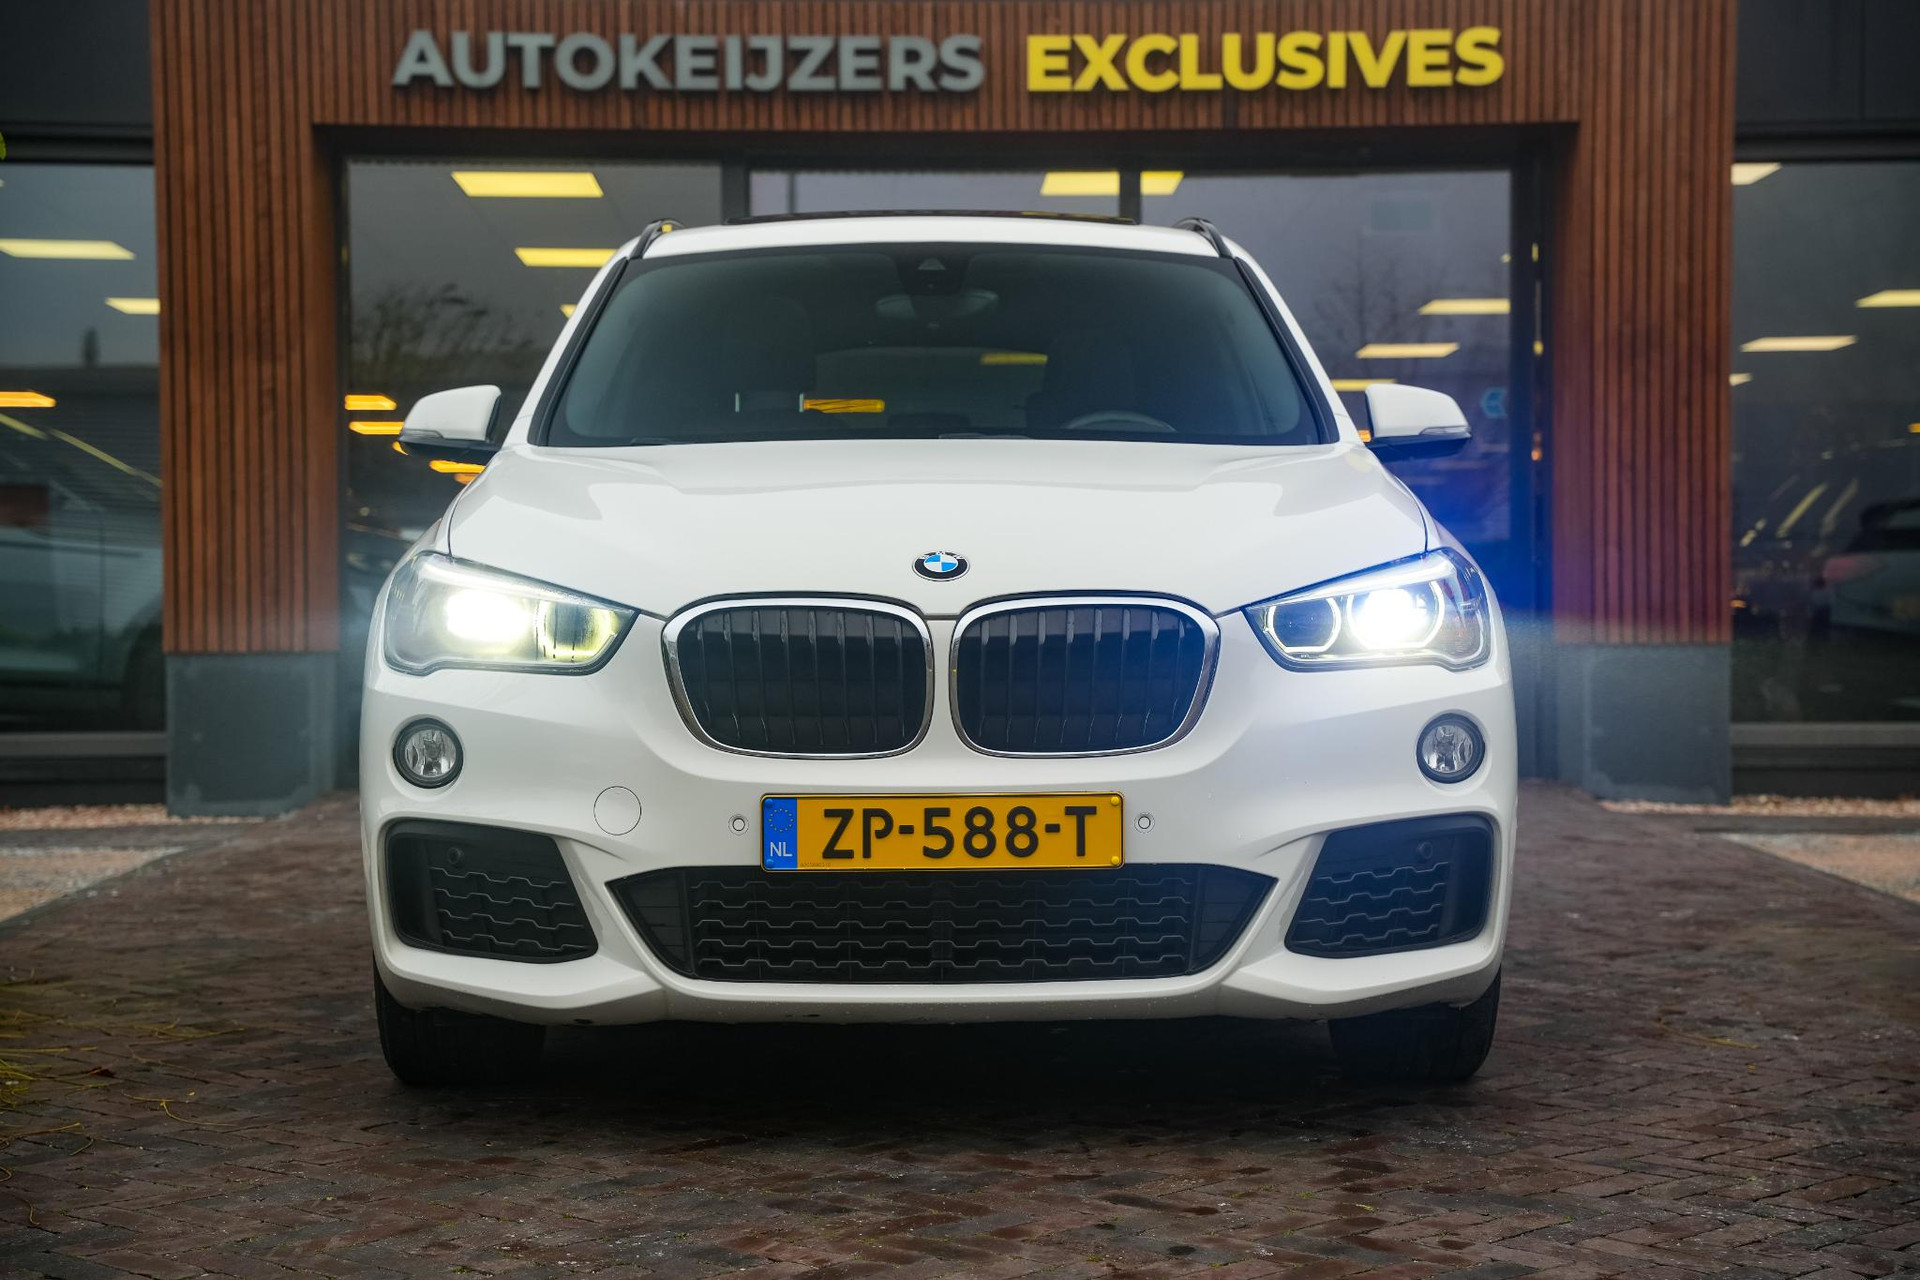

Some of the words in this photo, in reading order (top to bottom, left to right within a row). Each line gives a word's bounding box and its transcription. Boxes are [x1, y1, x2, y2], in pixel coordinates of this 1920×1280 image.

[392, 29, 985, 92] AUTOKEIJZERS
[1026, 26, 1505, 92] EXCLUSIVES
[770, 841, 793, 857] NL
[822, 805, 1098, 860] ZP-588-T
